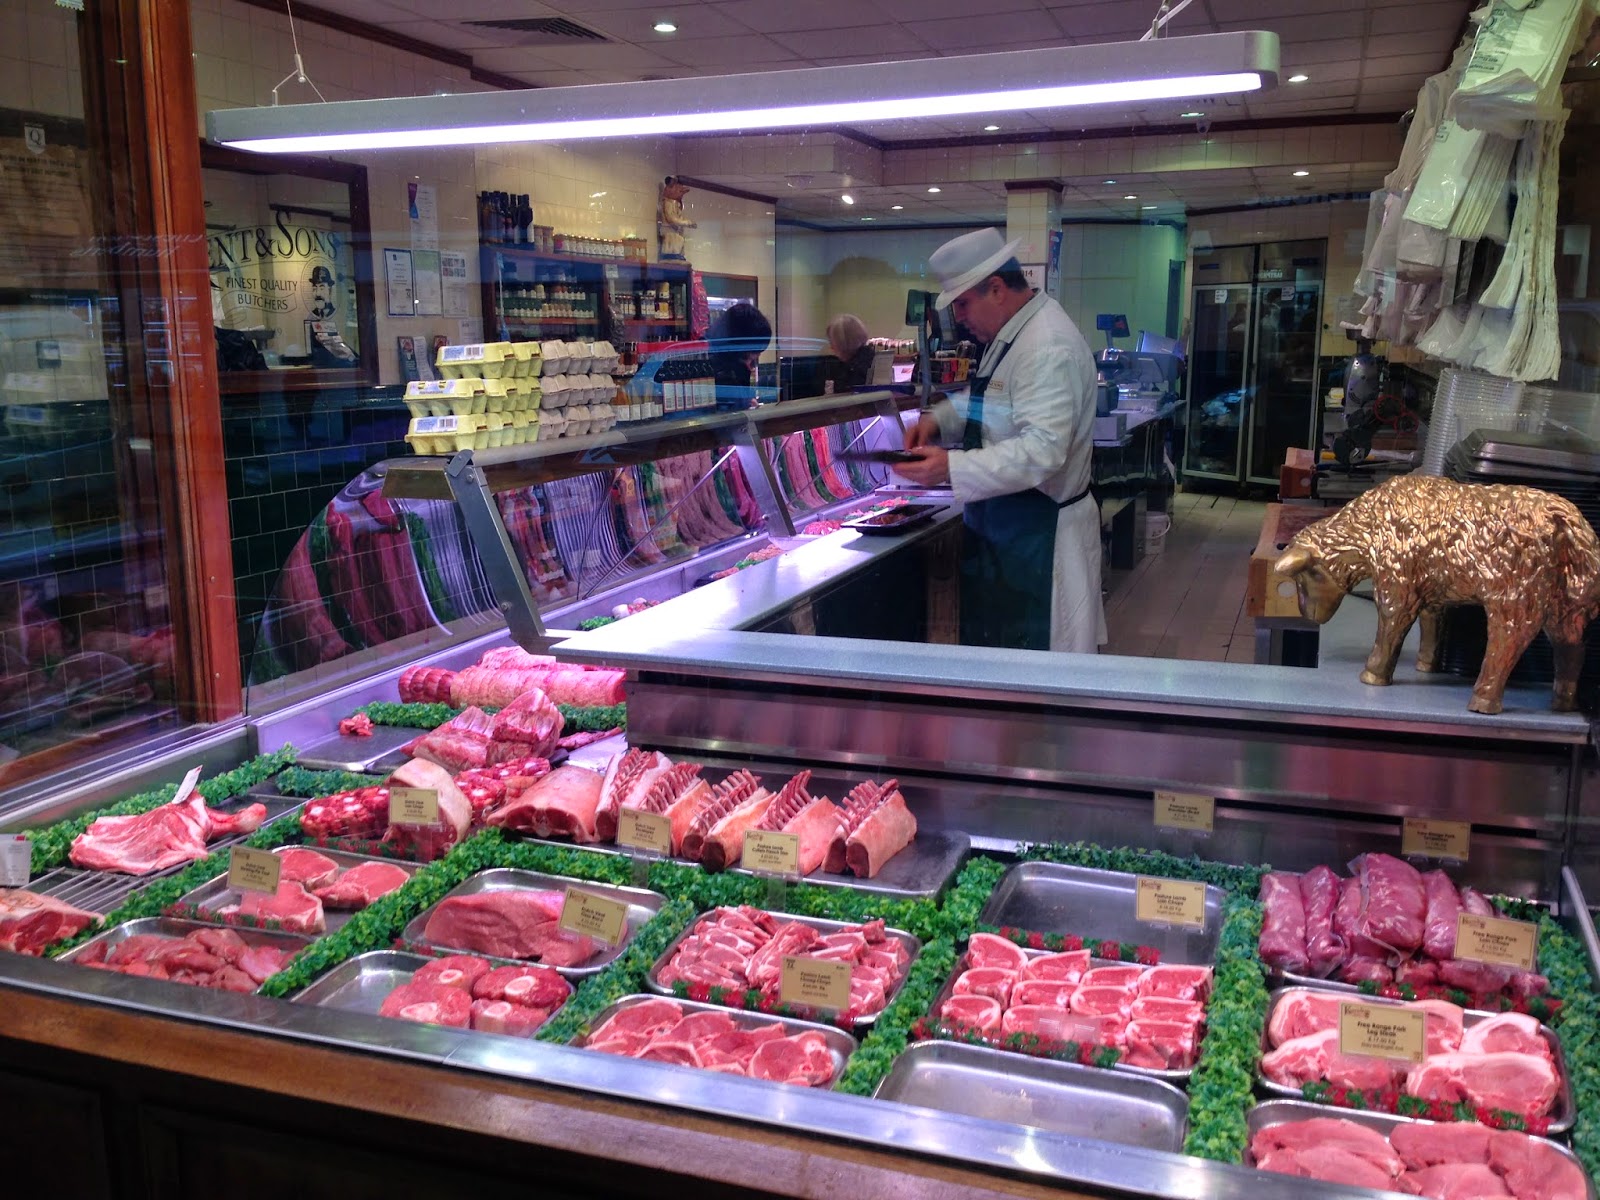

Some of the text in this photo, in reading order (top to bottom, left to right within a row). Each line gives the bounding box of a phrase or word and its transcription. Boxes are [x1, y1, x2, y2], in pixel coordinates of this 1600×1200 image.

[225, 277, 298, 292] FINEST QUALITY
[237, 293, 289, 310] BUTCHERS
[1486, 932, 1503, 940] Range
[1372, 1022, 1391, 1031] Range
